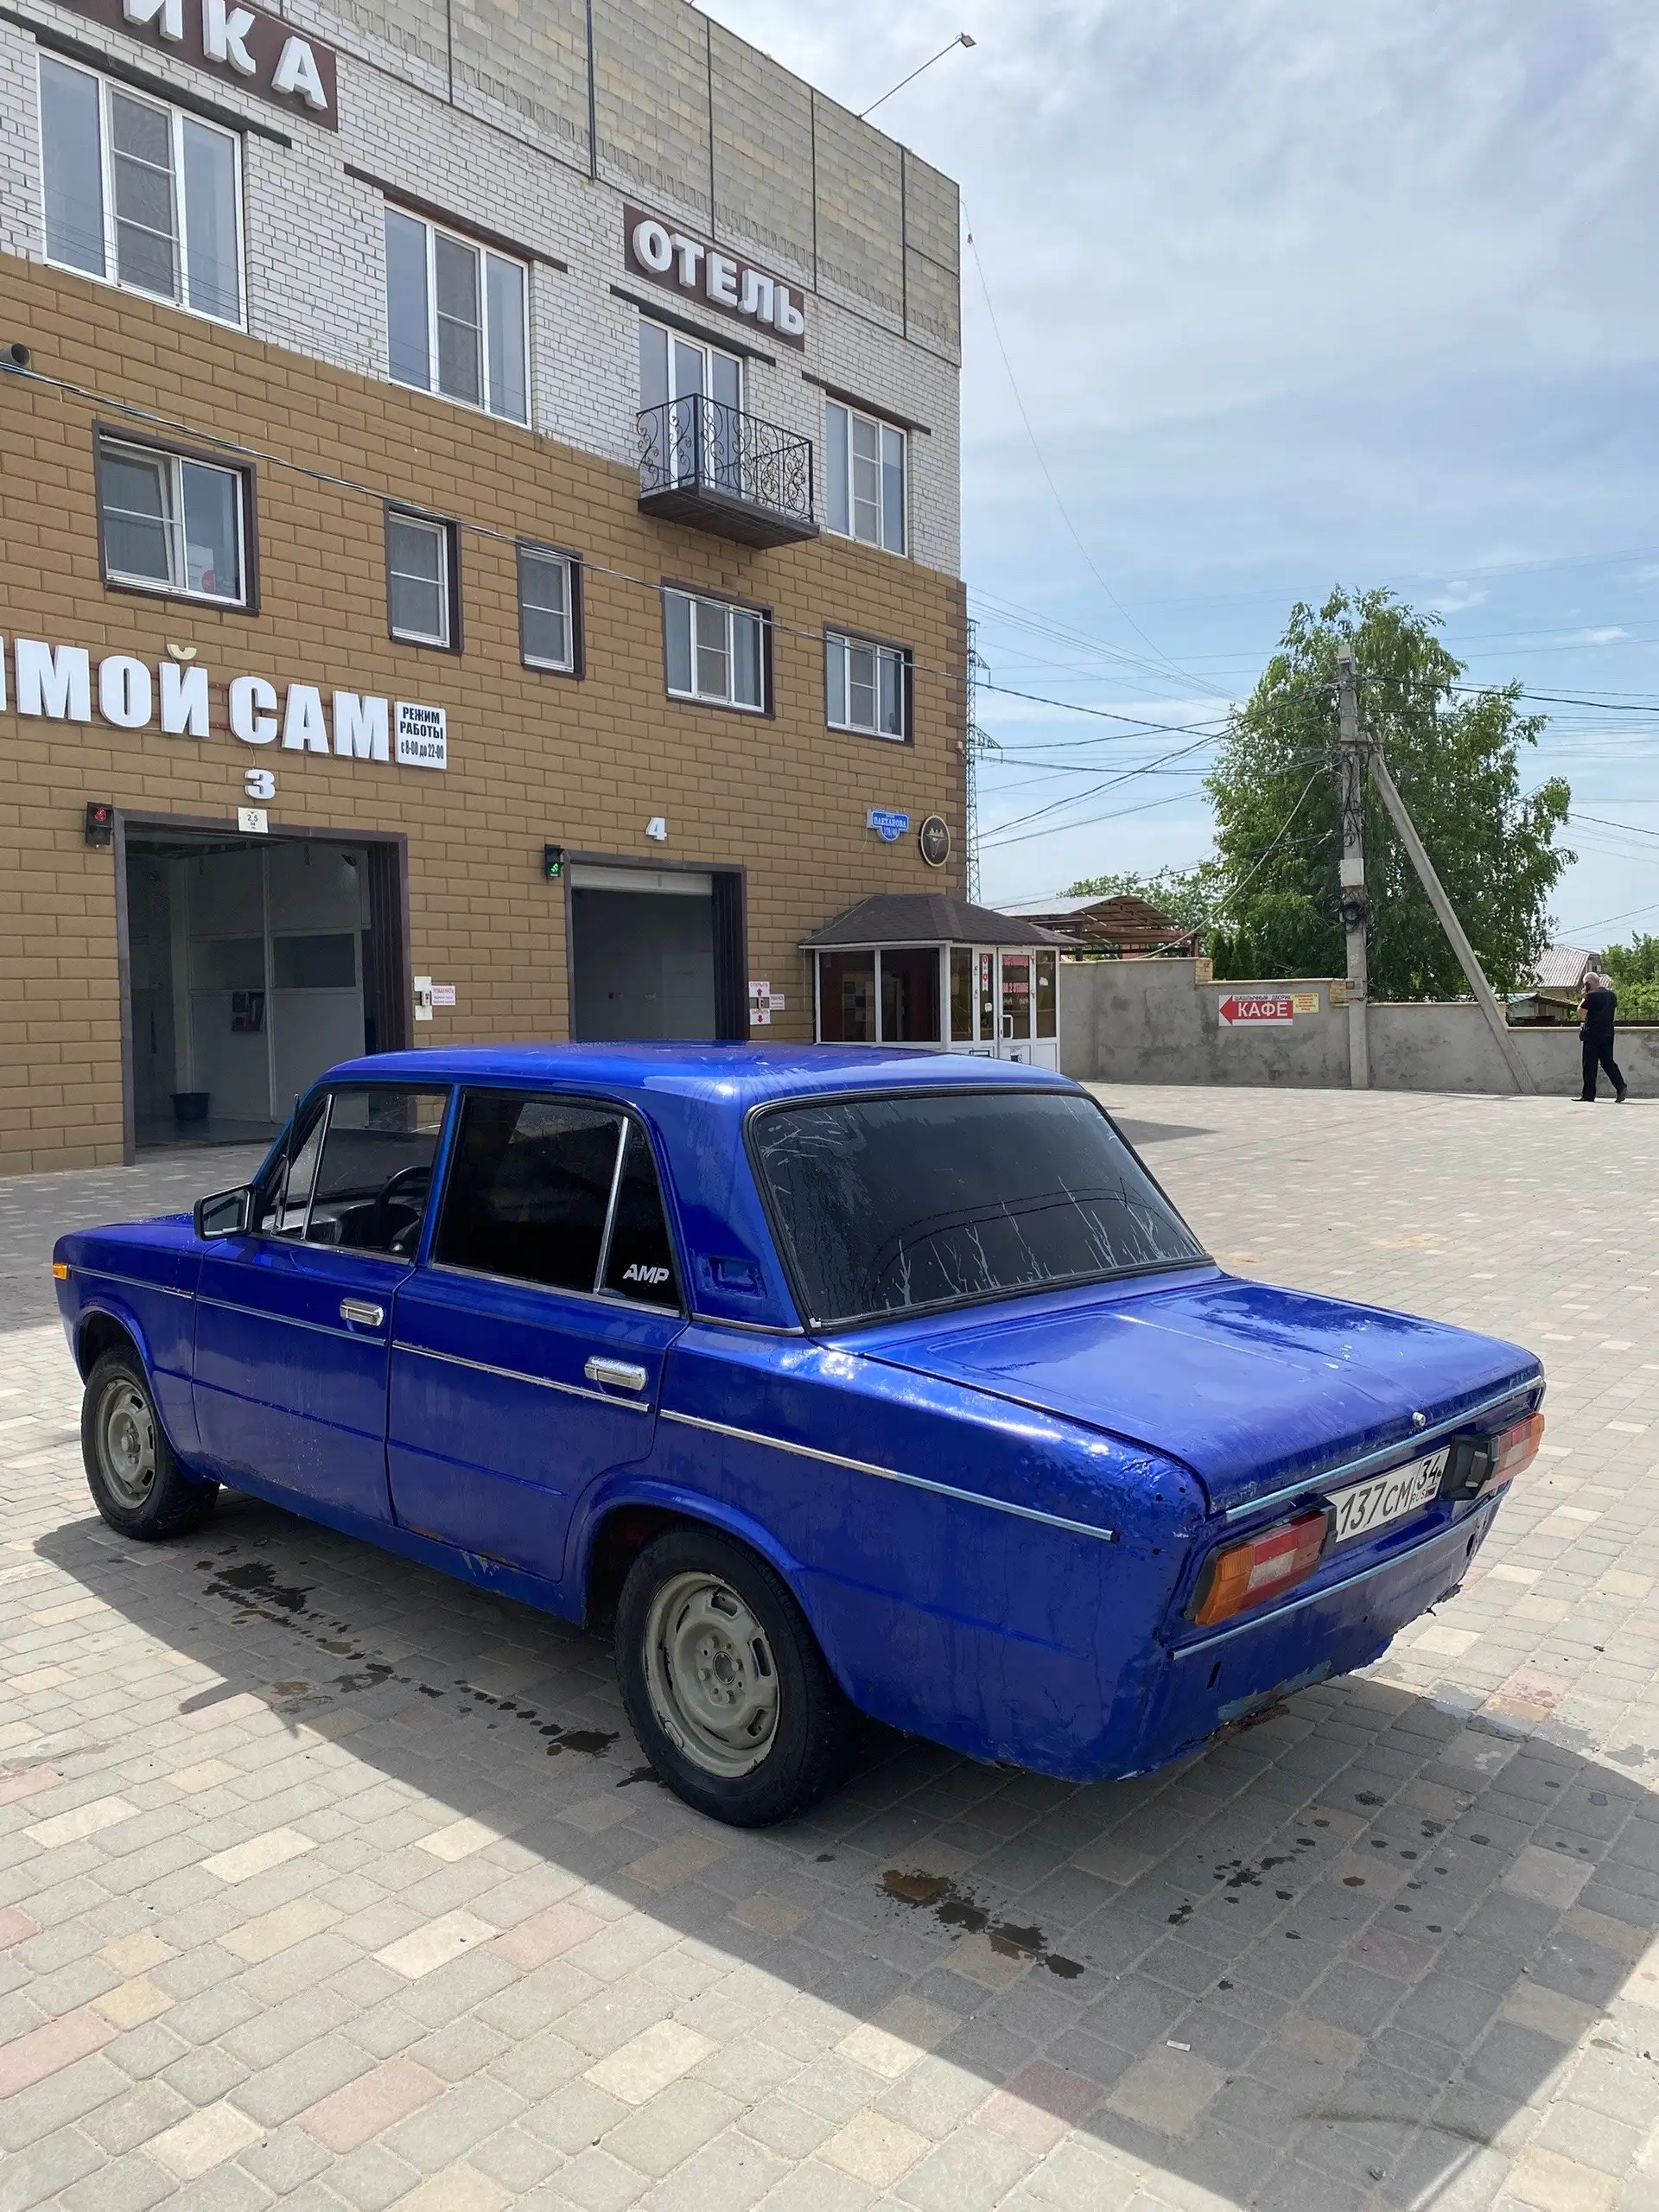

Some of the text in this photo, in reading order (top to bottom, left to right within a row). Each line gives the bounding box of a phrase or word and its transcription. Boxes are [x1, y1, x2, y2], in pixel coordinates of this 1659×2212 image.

[632, 219, 804, 336] ОТЕЛЬ
[0, 635, 389, 761] МОЙ САМ
[403, 706, 440, 724] РЕЖИМ
[399, 721, 443, 740] РАБОТЫ
[405, 740, 419, 756] 8-00
[419, 744, 428, 760] до
[428, 743, 444, 760] 22-00
[245, 769, 276, 799] 3
[645, 817, 667, 841] 4
[1237, 1001, 1288, 1017] КАФЕ
[623, 1263, 670, 1284] AMP
[1417, 1455, 1441, 1491] 34
[1411, 1488, 1427, 1503] RUS
